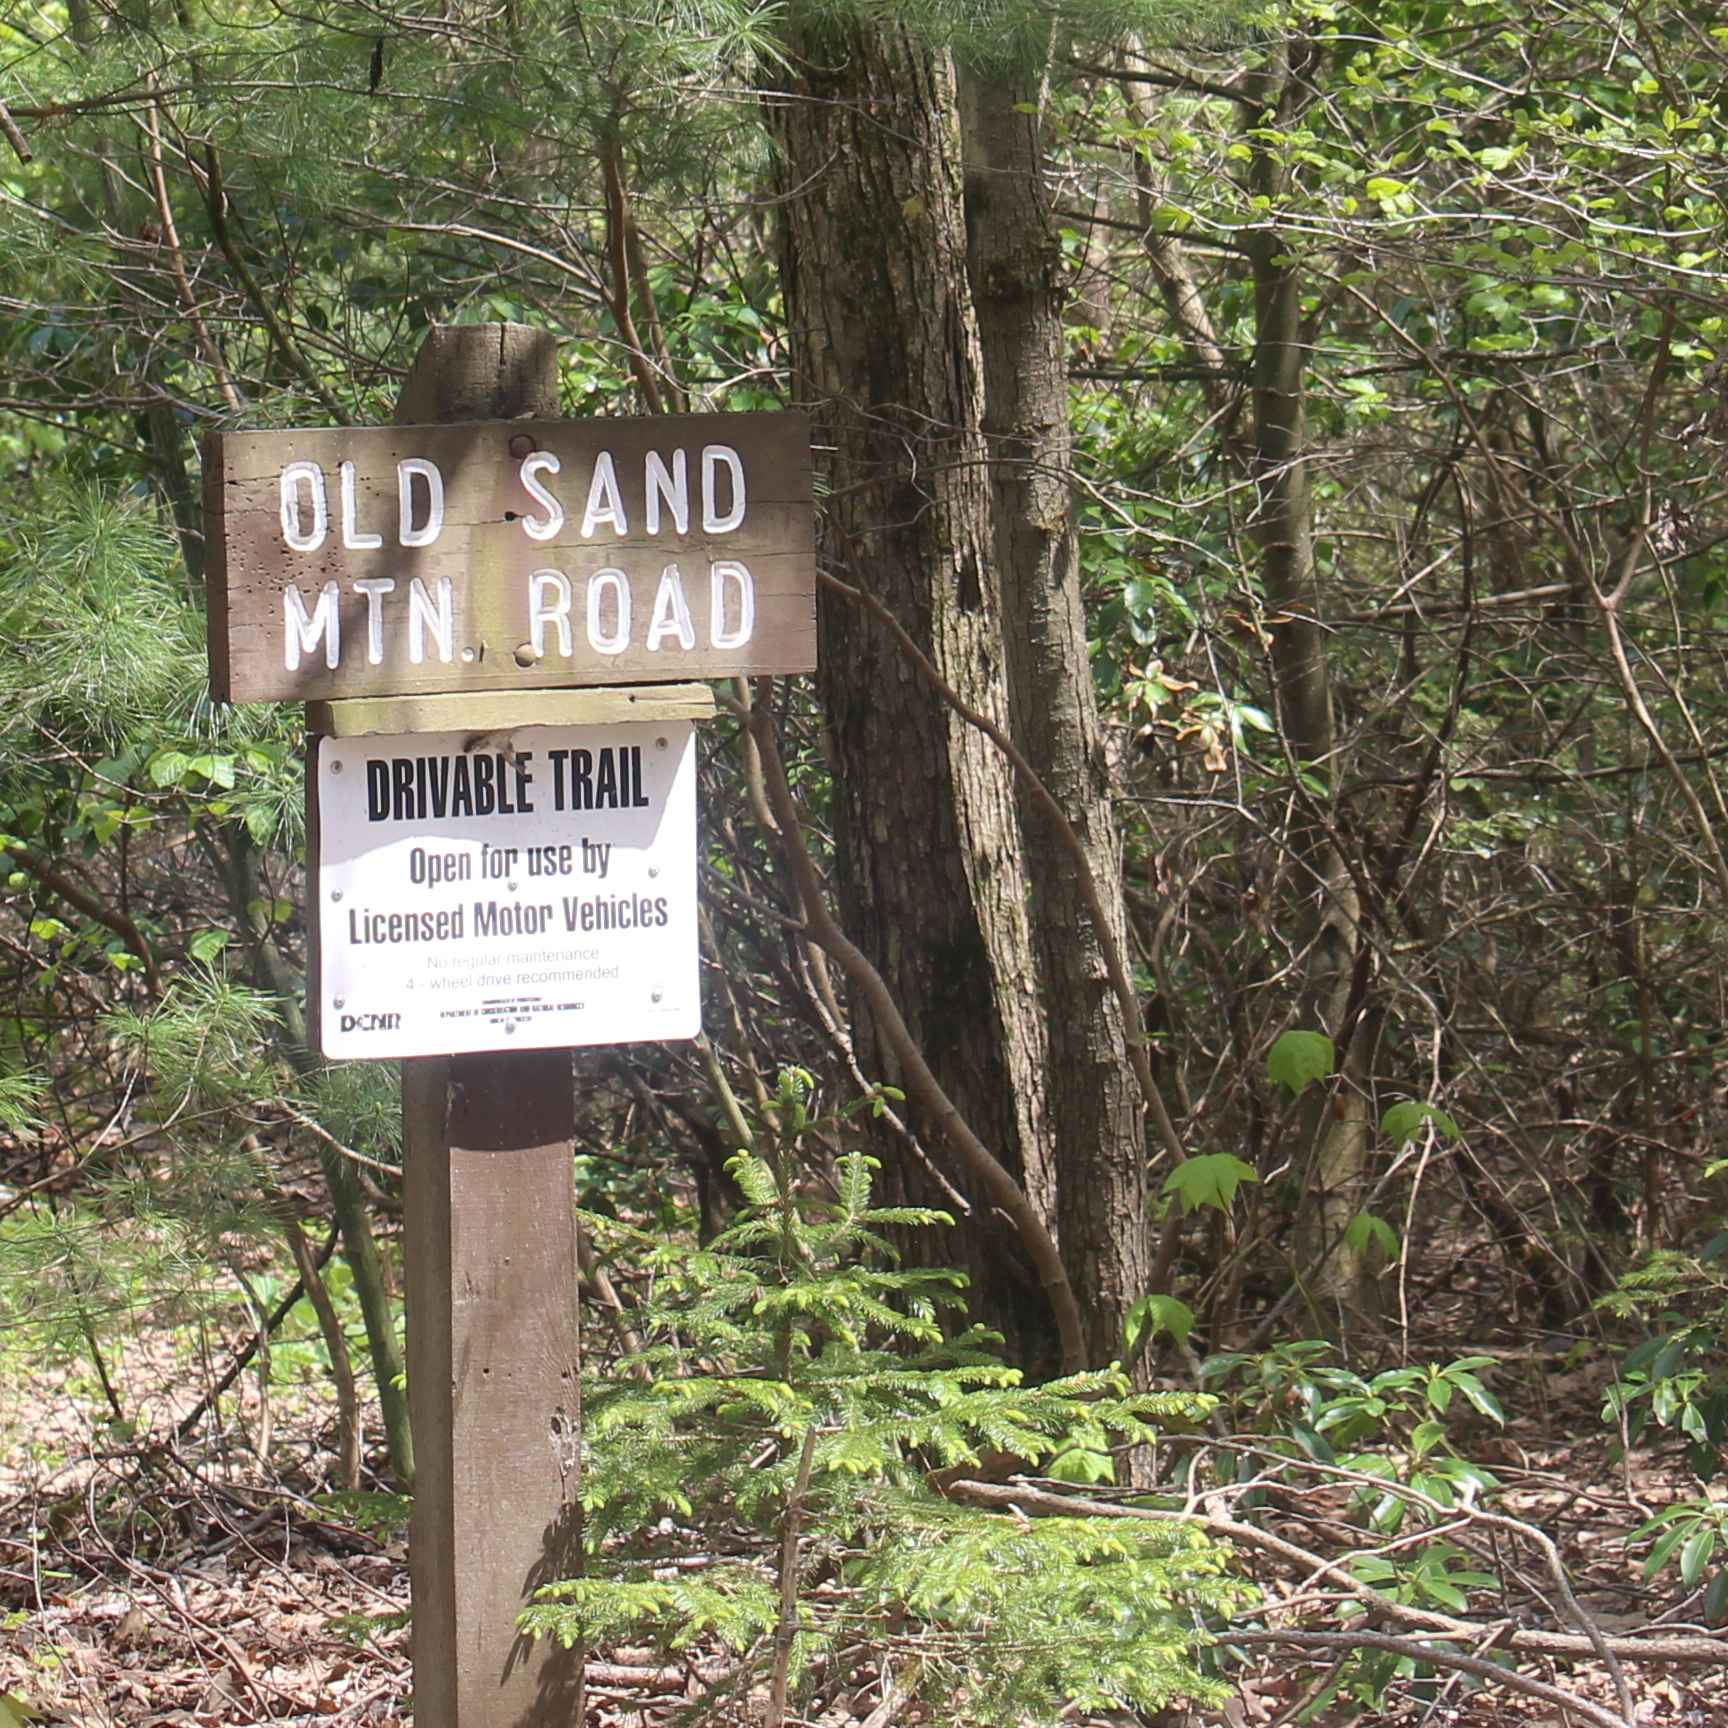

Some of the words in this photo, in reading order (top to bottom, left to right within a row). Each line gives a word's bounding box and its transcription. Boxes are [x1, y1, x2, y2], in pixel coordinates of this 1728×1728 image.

[279, 458, 446, 552] OLD
[520, 444, 747, 541] SAND
[284, 575, 475, 671] MTN.
[528, 561, 757, 657] ROAD
[366, 751, 535, 822] DRIVABLE
[548, 746, 649, 811] TRAIL
[410, 847, 472, 888] Open
[481, 843, 518, 878] for
[527, 844, 572, 877] use
[582, 838, 611, 878] by
[349, 904, 464, 945] Licensed
[474, 901, 553, 937] Motor
[563, 893, 668, 932] Vehicles
[477, 970, 512, 988] drive
[516, 964, 620, 984] recommended
[507, 947, 600, 966] maintenance
